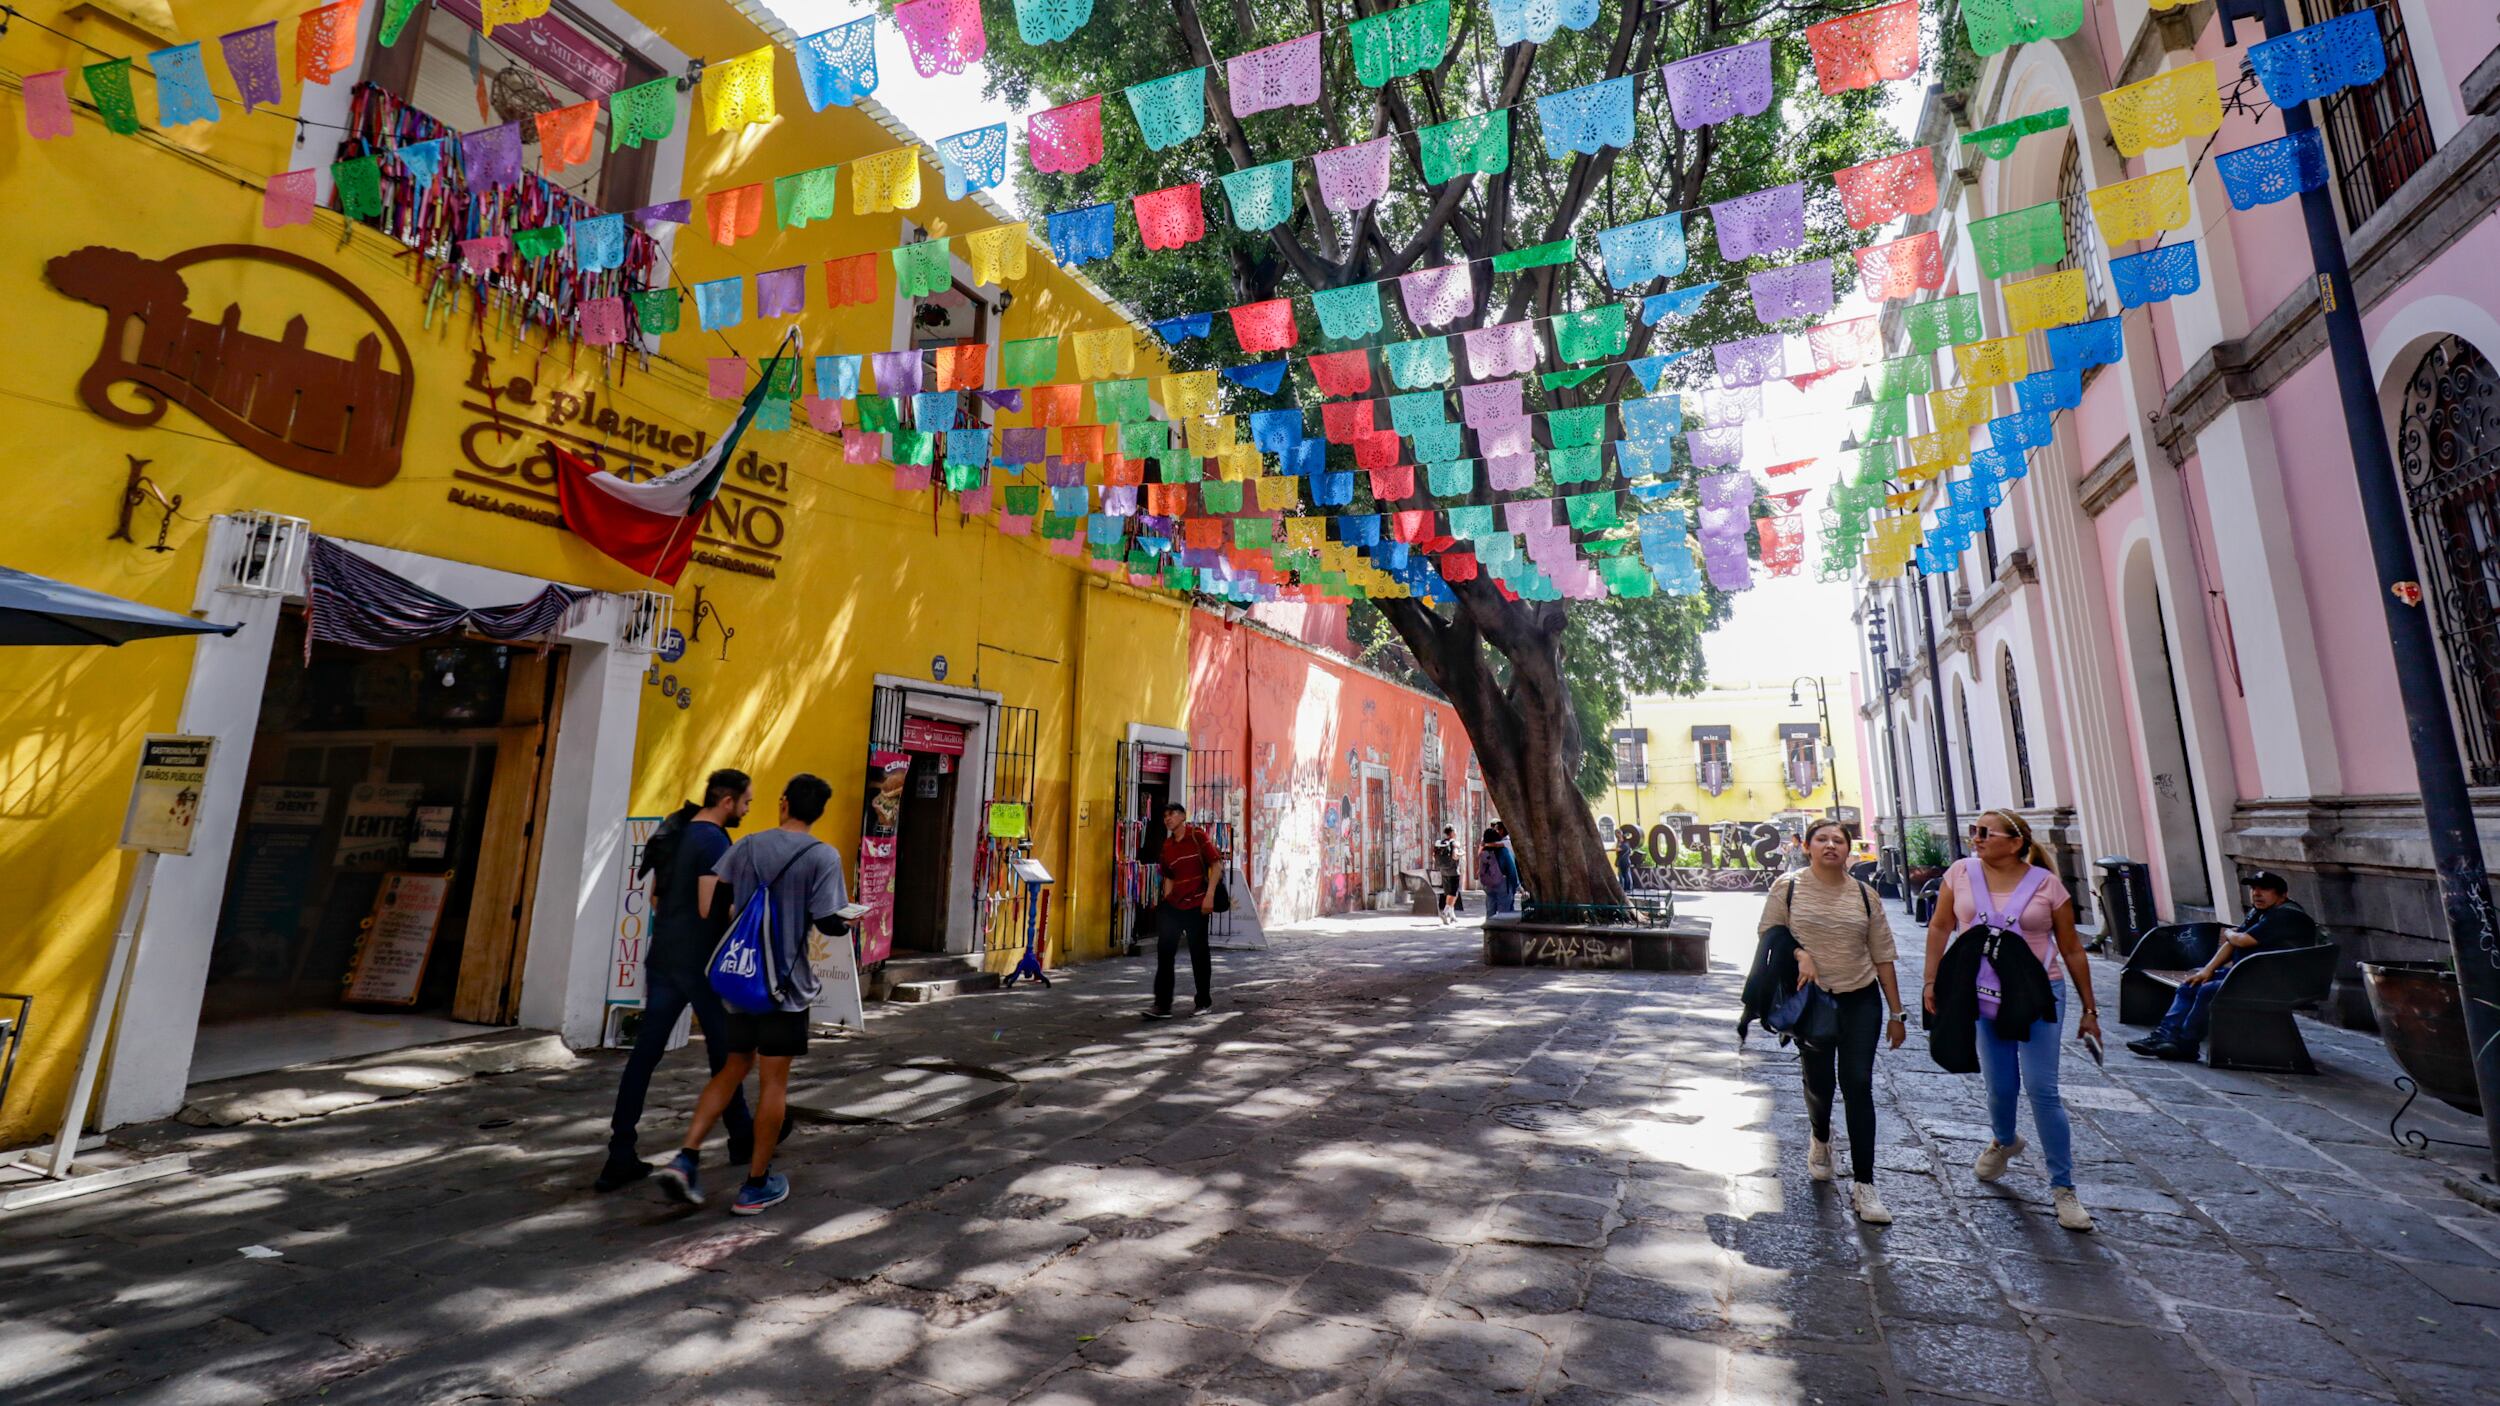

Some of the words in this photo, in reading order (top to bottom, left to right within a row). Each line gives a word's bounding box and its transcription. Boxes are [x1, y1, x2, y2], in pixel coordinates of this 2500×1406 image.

[550, 42, 617, 92] MILAGROS
[464, 348, 536, 406] La
[545, 389, 714, 460] plazuel
[736, 451, 790, 492] del
[447, 487, 502, 512] PLAZA
[646, 663, 692, 709] 106
[903, 728, 917, 739] AFÉ
[932, 732, 963, 745] MILAGROS
[144, 768, 170, 781] BAÑOS
[274, 801, 318, 813] DENT
[615, 820, 652, 988] WELCOME
